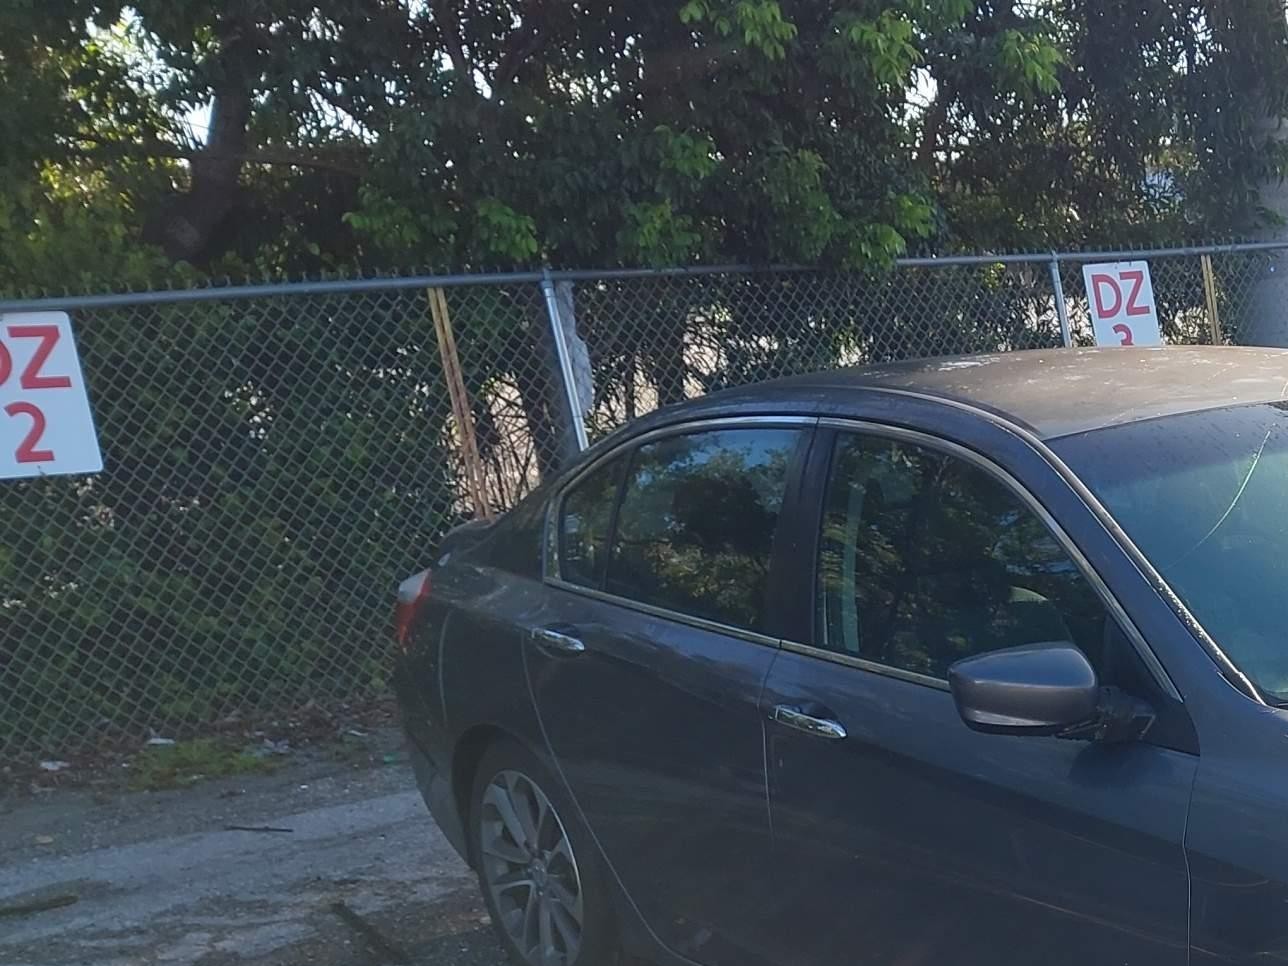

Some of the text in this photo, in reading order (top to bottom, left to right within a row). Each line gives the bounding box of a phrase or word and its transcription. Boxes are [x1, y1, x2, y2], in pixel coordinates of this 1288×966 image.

[1091, 270, 1151, 319] DZ
[0, 325, 72, 390] Z
[4, 401, 55, 464] 2
